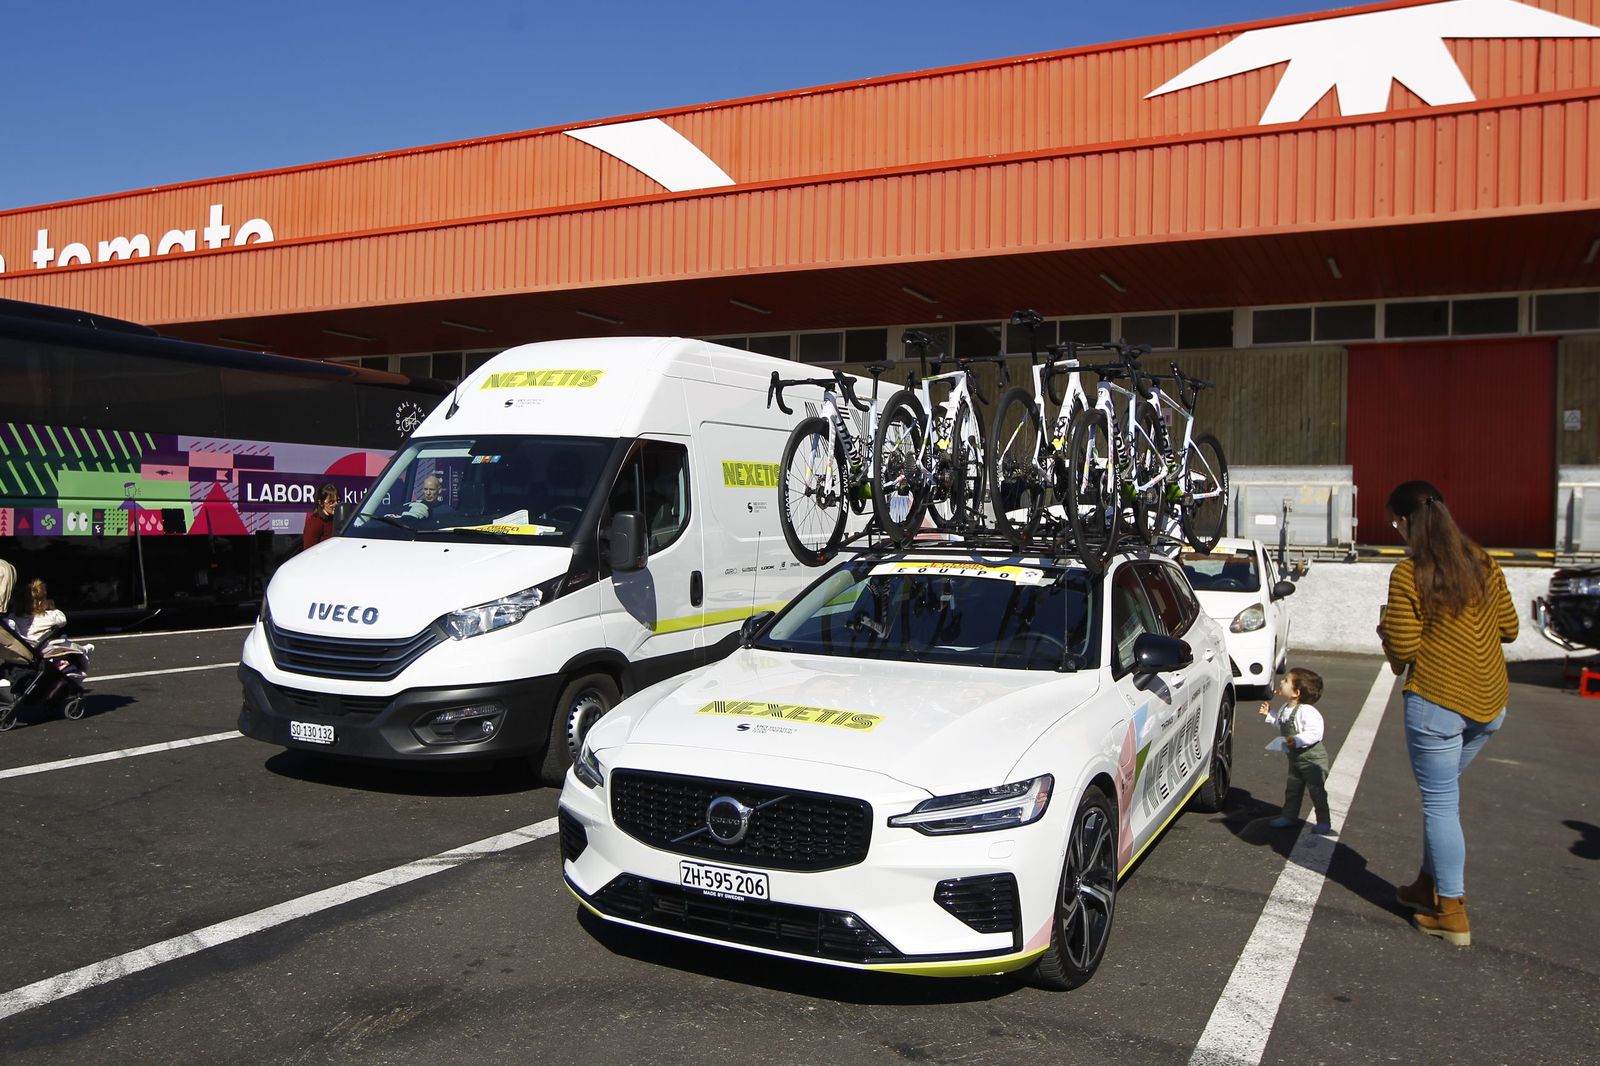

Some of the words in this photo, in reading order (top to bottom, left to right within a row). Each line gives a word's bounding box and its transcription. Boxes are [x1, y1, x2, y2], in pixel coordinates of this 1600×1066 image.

[480, 369, 604, 389] NEXETIS
[841, 464, 849, 494] SWISS
[247, 482, 316, 503] LABOR
[842, 494, 849, 514] DT
[897, 566, 1010, 579] EQUIPO
[308, 602, 379, 625] IVECO
[698, 700, 880, 730] NEXETIS
[318, 727, 333, 740] 132
[703, 889, 717, 897] MADE
[724, 892, 745, 901] SWEDEN
[736, 875, 764, 896] 206
